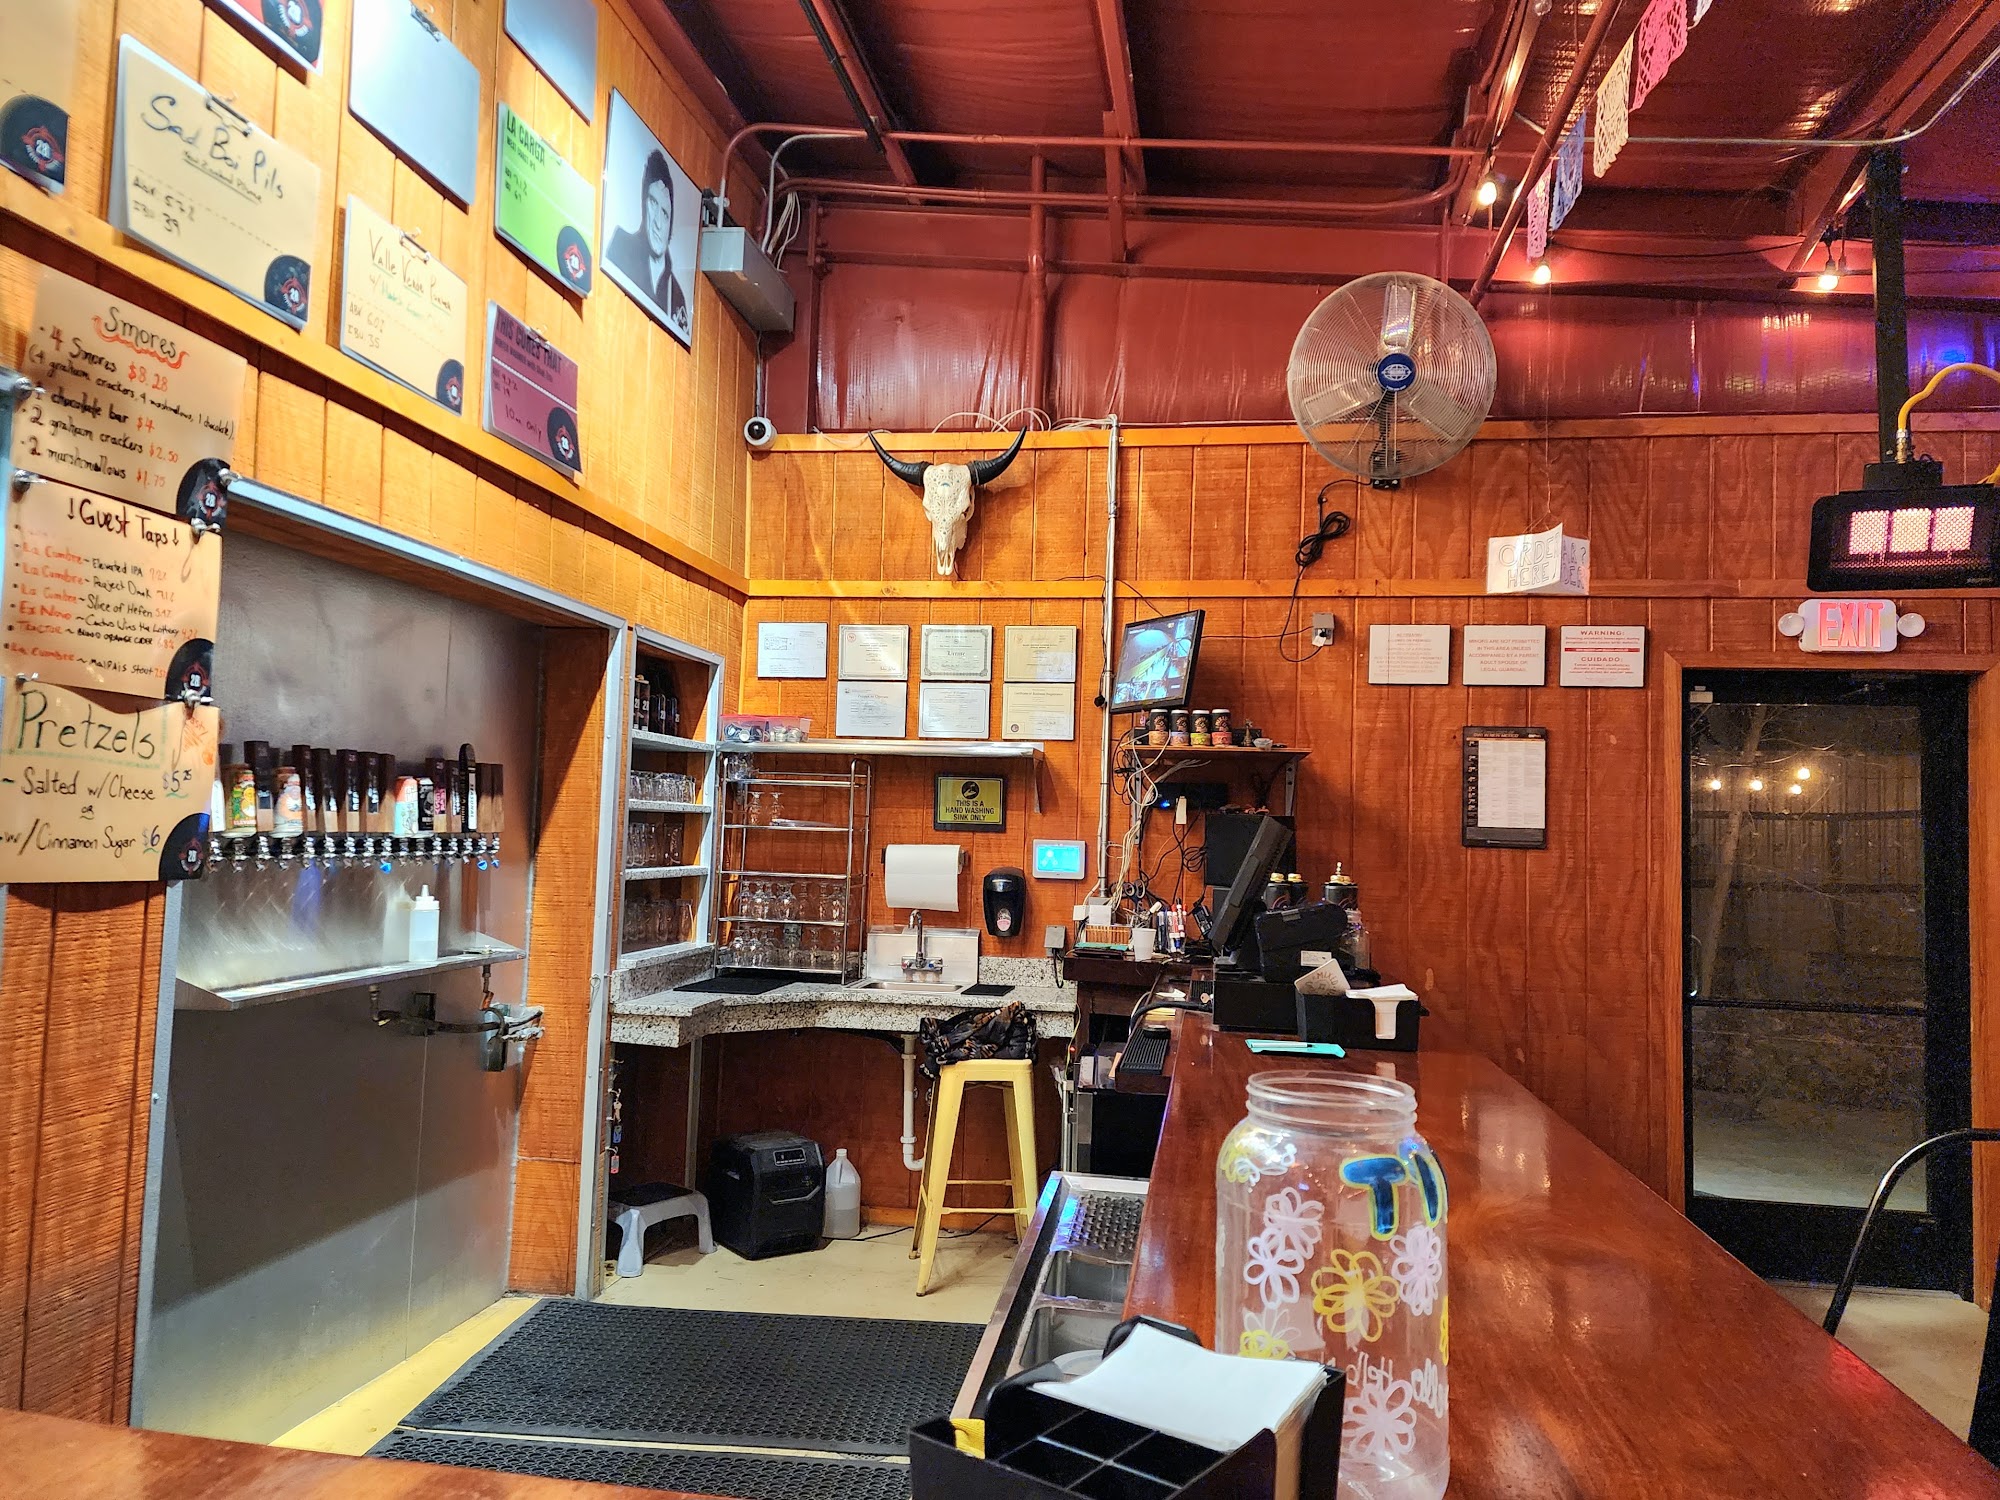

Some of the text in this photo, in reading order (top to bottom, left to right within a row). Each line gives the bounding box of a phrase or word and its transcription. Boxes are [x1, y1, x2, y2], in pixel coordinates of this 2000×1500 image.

[36, 139, 52, 159] 28
[141, 96, 201, 149] Sad
[210, 127, 242, 169] Boi
[253, 150, 283, 199] Pils
[507, 110, 545, 167] LA CARGA
[369, 229, 397, 275] Valle
[104, 306, 177, 359] Smores
[368, 334, 380, 349] 35
[496, 310, 514, 341] THIS
[543, 348, 562, 375] THAT
[50, 325, 169, 392] 4 Smores $8.28
[49, 359, 90, 382] graham
[139, 392, 147, 405] 4
[50, 386, 101, 419] chocolate
[108, 408, 129, 424] bar
[136, 416, 155, 433] $4
[29, 406, 179, 464] 2 graham crackers $2.50
[28, 436, 166, 488] 2 marshmallows $1.75
[205, 493, 216, 508] 28
[79, 498, 169, 547] Guest Taps
[21, 562, 39, 576] La
[41, 565, 84, 585] Cumbre
[22, 541, 39, 555] La
[45, 543, 84, 565] Cumbre
[92, 557, 127, 574] Elevated
[131, 564, 143, 577] IPA
[19, 600, 36, 615] Ex
[40, 605, 73, 621] Novo
[21, 583, 37, 595] La
[43, 585, 78, 605] Cumbre
[87, 594, 111, 614] Slice
[112, 603, 125, 615] of
[128, 603, 153, 619] Hefen
[1819, 602, 1884, 648] EXIT
[31, 645, 76, 661] Cumbre
[130, 662, 154, 676] Stout
[190, 674, 201, 687] 28
[17, 690, 155, 759] Pretzels
[20, 766, 80, 795] Salted
[945, 806, 995, 815] HAND WASHING
[102, 826, 136, 858] Sugar
[142, 825, 161, 848] $6
[188, 849, 198, 863] 28
[1317, 971, 1339, 985] MIXED
